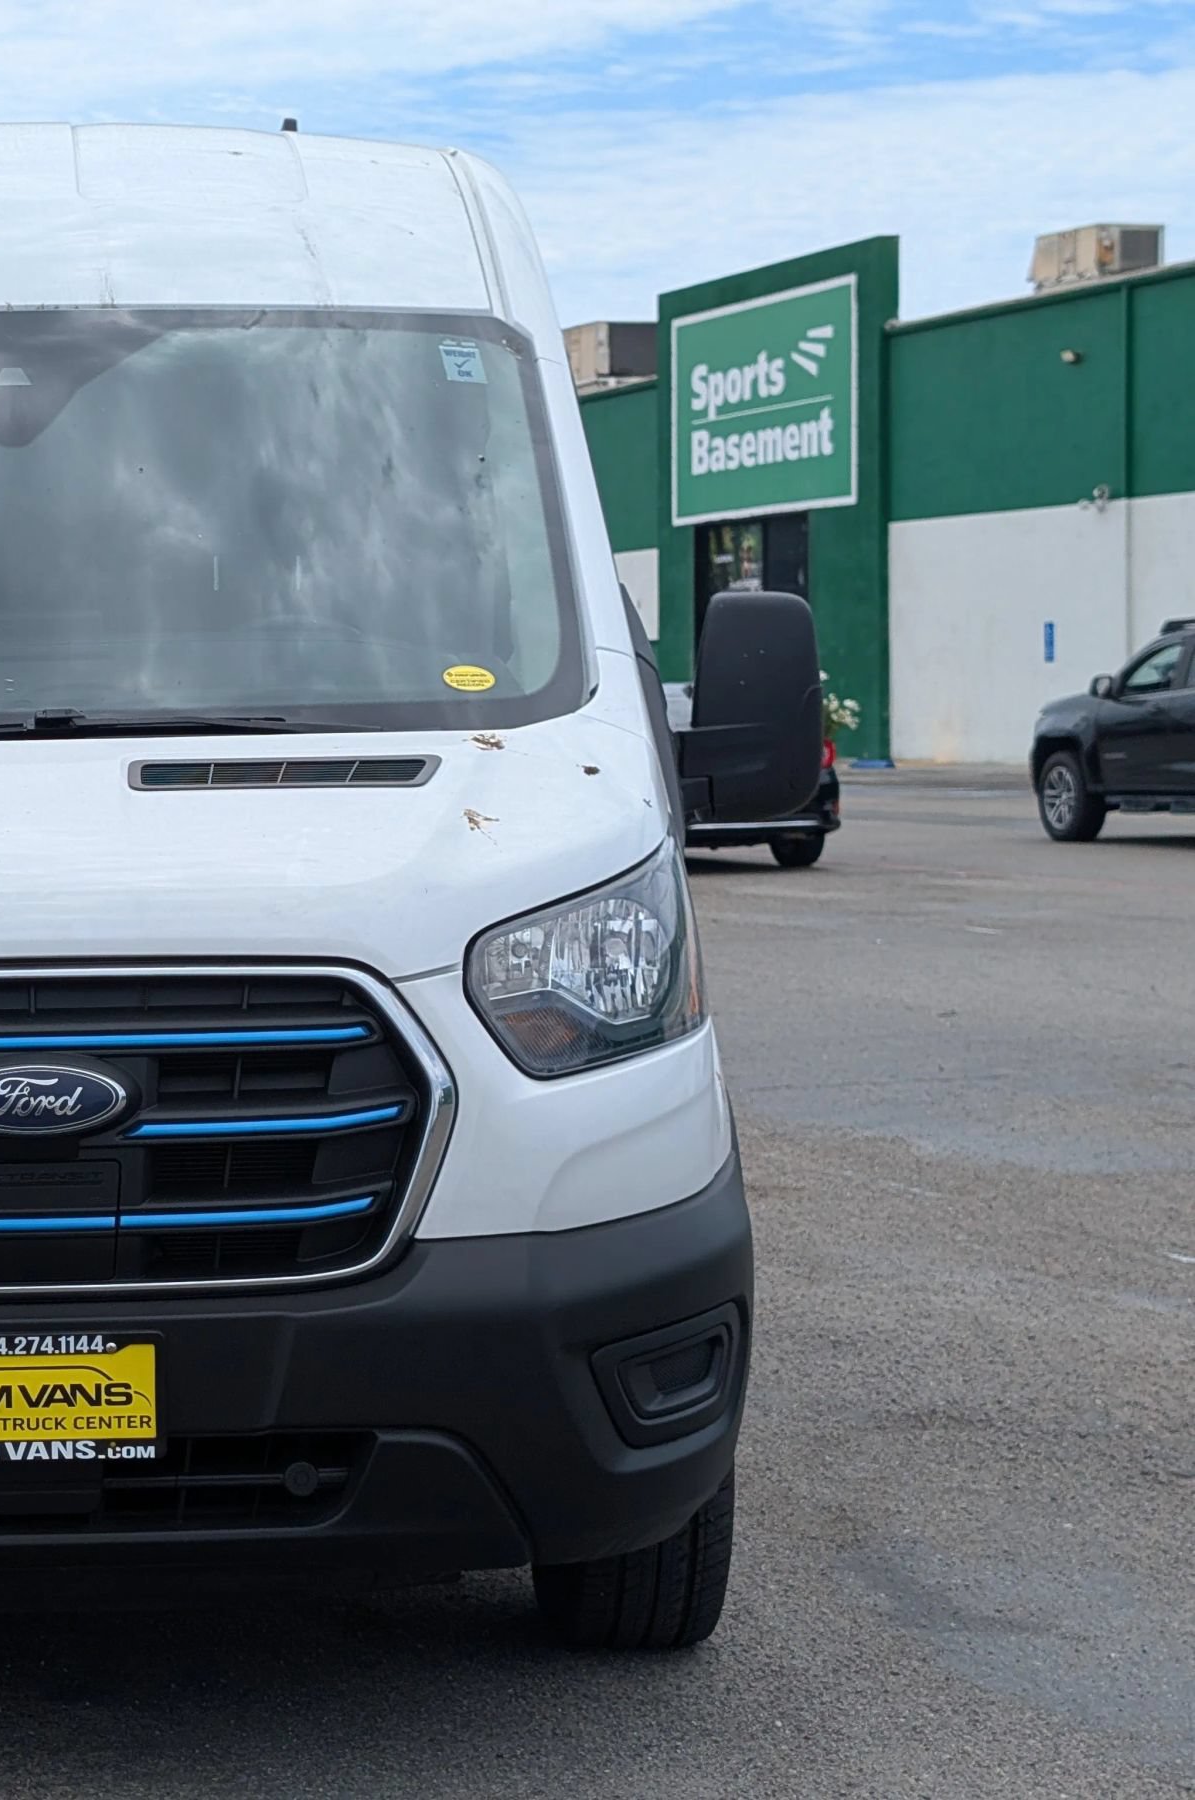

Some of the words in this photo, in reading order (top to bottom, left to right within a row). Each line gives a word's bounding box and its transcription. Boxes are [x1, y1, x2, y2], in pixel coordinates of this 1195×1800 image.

[691, 350, 786, 421] Sports
[691, 406, 835, 476] Basement
[17, 1382, 133, 1409] VANS
[0, 1416, 67, 1431] TRUCK
[73, 1415, 152, 1430] CENTER
